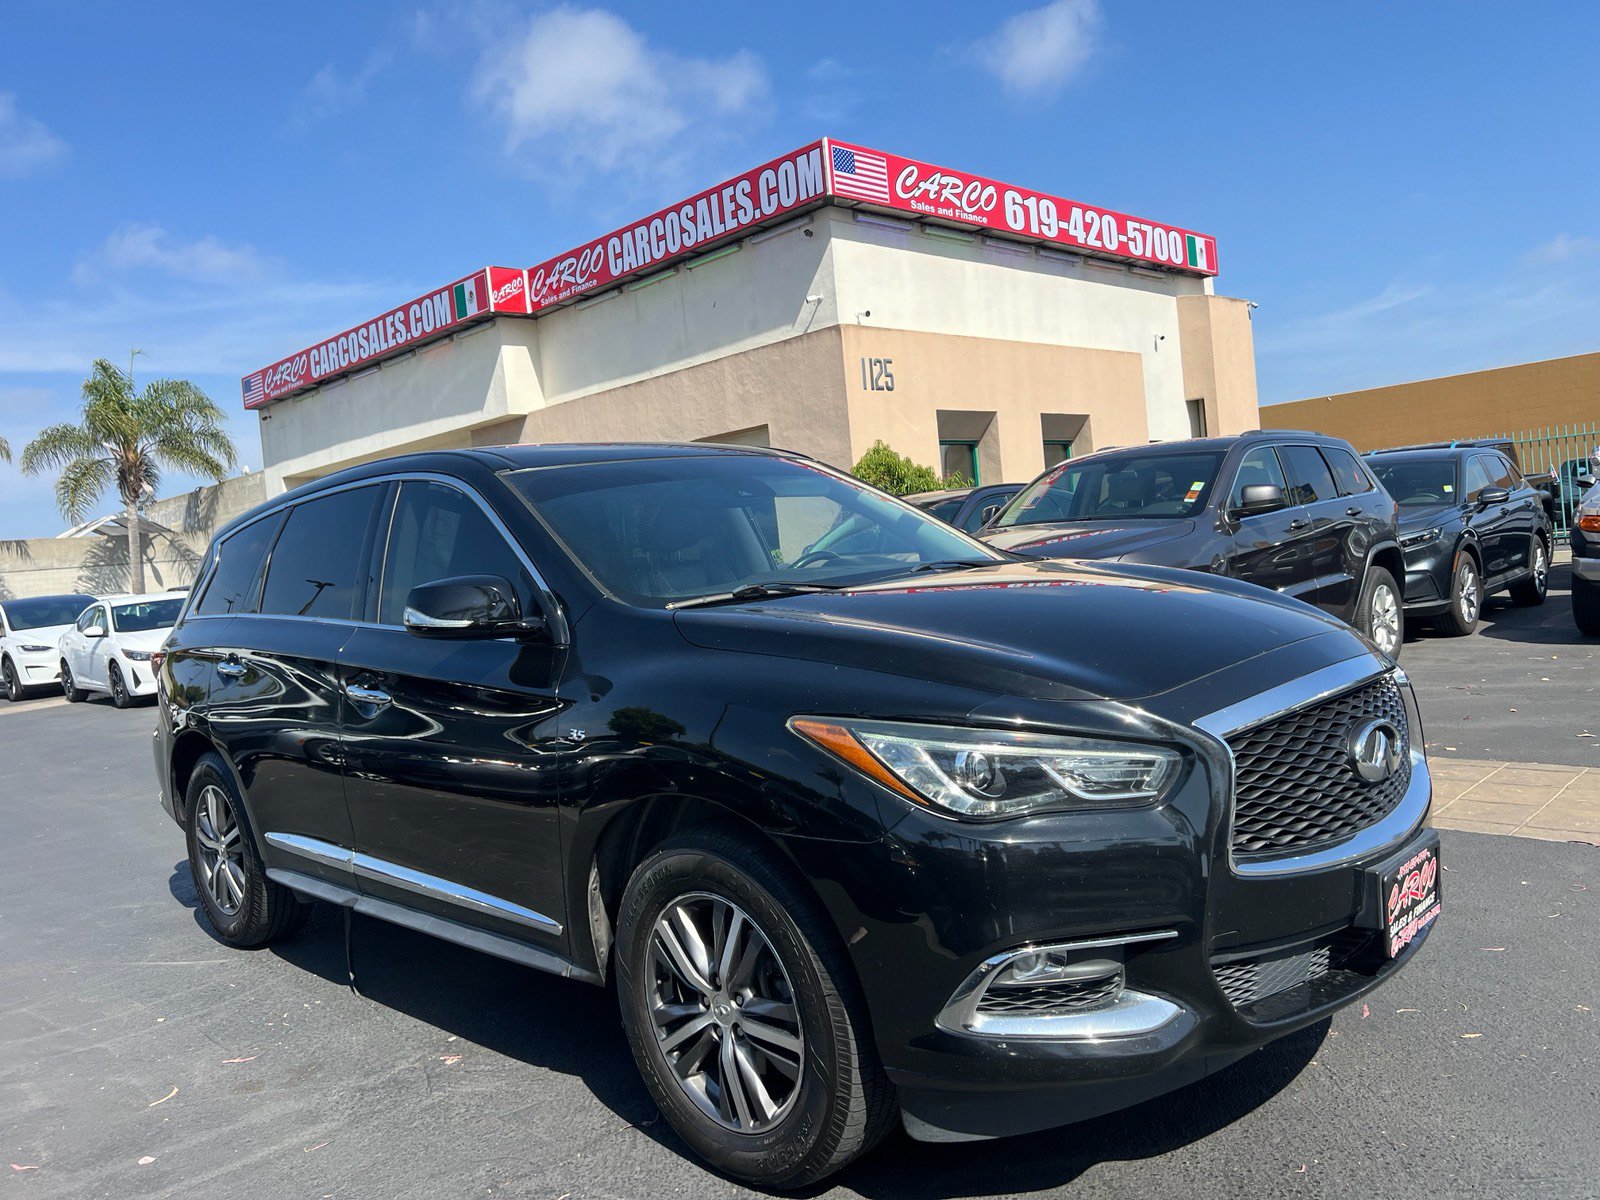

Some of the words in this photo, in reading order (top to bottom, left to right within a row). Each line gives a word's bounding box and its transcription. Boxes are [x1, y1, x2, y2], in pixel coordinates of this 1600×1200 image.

[530, 243, 604, 302] CARCO
[606, 147, 825, 277] CARCOSALES.COM
[895, 165, 998, 213] CARCO
[1004, 189, 1184, 265] 619-420-5700
[910, 199, 936, 213] Sales
[937, 207, 953, 218] and
[955, 209, 988, 225] Finance
[492, 276, 522, 303] CARCO
[540, 293, 558, 307] Sales
[558, 288, 571, 300] and
[571, 278, 598, 295] Finance
[264, 353, 308, 394] CARCO
[309, 289, 453, 379] CARCOSALES.COM
[860, 357, 895, 391] 1125
[1388, 856, 1436, 925] CARCO
